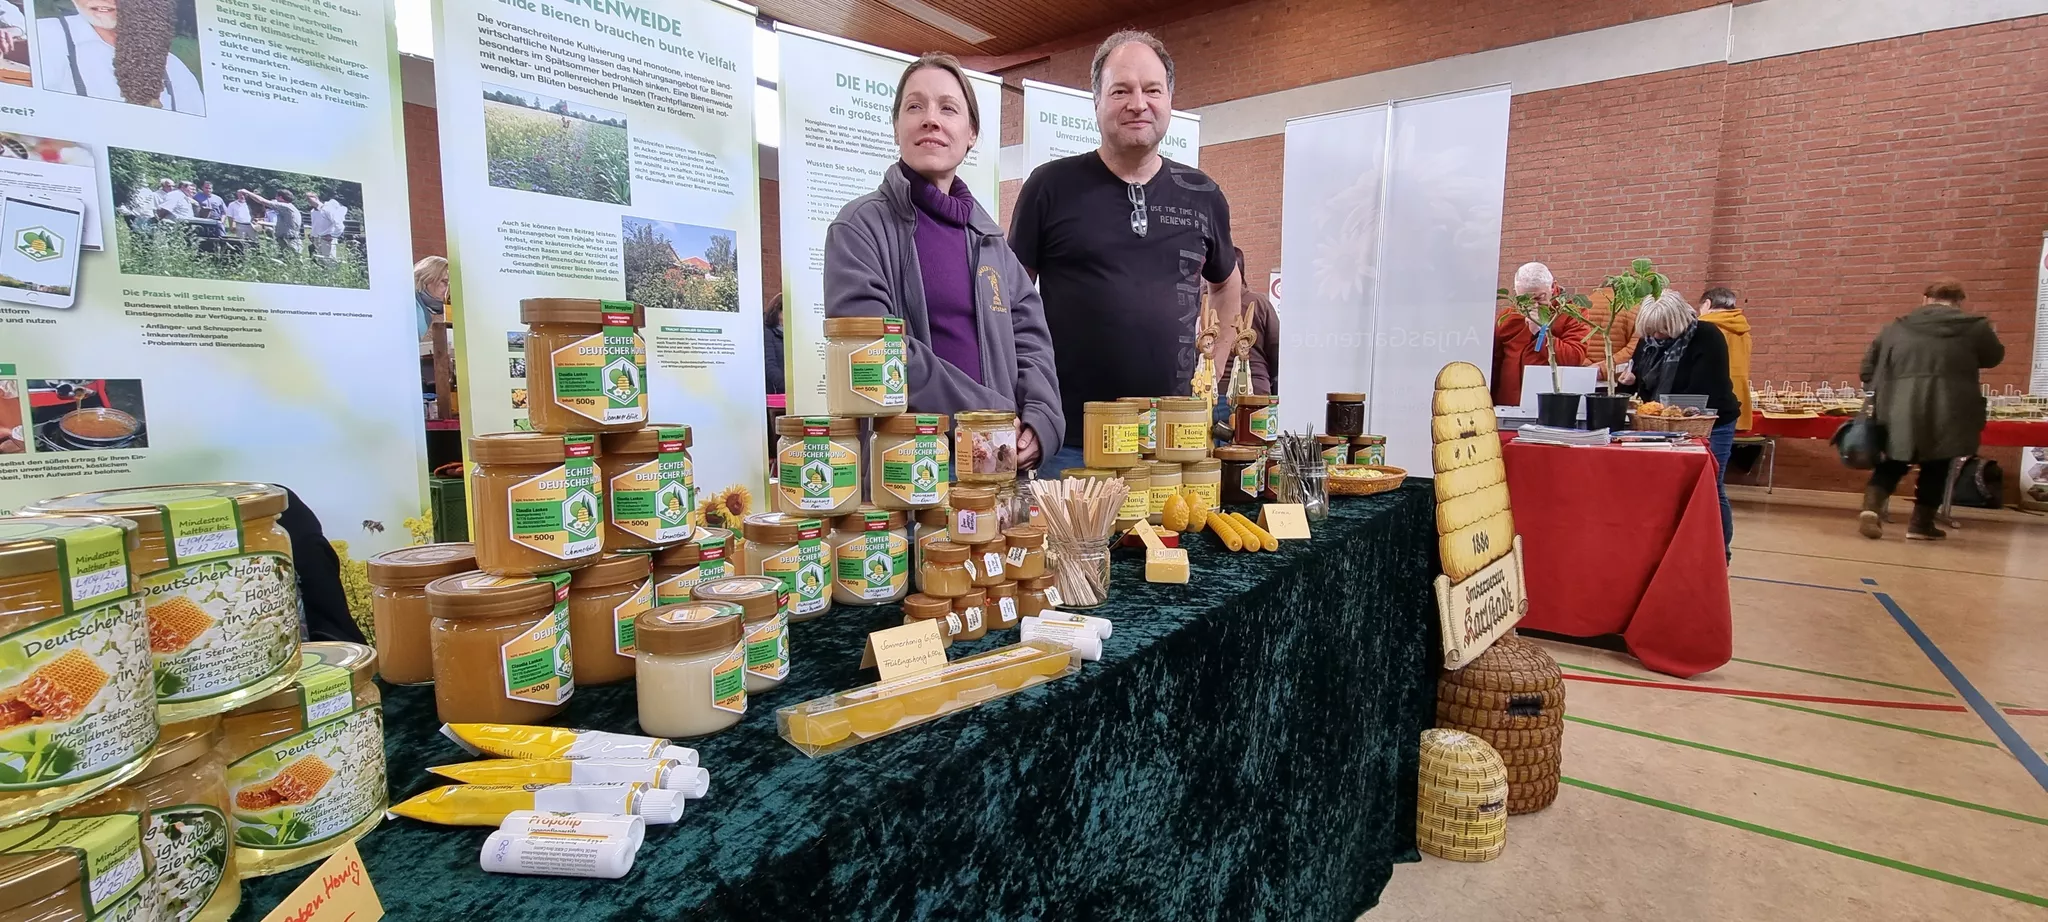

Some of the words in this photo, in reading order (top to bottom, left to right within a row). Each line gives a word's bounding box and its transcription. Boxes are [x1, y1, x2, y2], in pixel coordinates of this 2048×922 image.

[216, 5, 251, 20] Beitrag
[254, 14, 267, 22] für
[270, 19, 290, 28] eine
[293, 23, 324, 38] intakte
[327, 33, 358, 46] Umwelt
[252, 4, 267, 12] Sie
[270, 9, 295, 20] einen
[298, 16, 343, 33] wertvollen
[218, 17, 236, 25] und
[240, 22, 258, 30] den
[261, 26, 318, 45] Klimaschutz.
[541, 3, 590, 29] Bienen
[595, 19, 655, 48] brauchen
[659, 38, 694, 59] bunte
[698, 50, 736, 72] Vielfalt
[219, 30, 265, 45] gewinnen
[268, 40, 282, 48] Sie
[285, 44, 325, 59] wertvolle
[328, 55, 368, 70] Naturpro-
[477, 12, 493, 24] Die
[496, 19, 574, 47] voranschreitende
[577, 41, 625, 62] Kultivierung
[627, 56, 642, 65] und
[644, 61, 683, 78] monotone,
[684, 71, 714, 86] intensive
[716, 80, 732, 90] land-
[220, 40, 249, 51] dukte
[252, 47, 270, 56] und
[273, 52, 288, 60] die
[291, 55, 345, 75] Möglichkeit,
[347, 69, 370, 80] diese
[478, 26, 547, 51] wirtschaftliche
[550, 45, 586, 62] Nutzung
[588, 55, 614, 68] lassen
[617, 64, 631, 72] das
[633, 67, 698, 91] Nahrungsangebot
[699, 85, 709, 93] für
[711, 88, 733, 100] Bienen
[479, 37, 529, 57] besonders
[532, 53, 542, 61] im
[545, 55, 599, 75] Spätsommer
[602, 69, 643, 86] bedrohlich
[645, 81, 671, 94] sinken.
[673, 88, 692, 98] Eine
[691, 92, 732, 110] Bienenweide
[222, 63, 258, 77] können
[262, 71, 277, 80] Sie
[279, 74, 288, 83] in
[290, 77, 318, 89] jedem
[321, 84, 341, 94] Alter
[343, 89, 370, 101] begin-
[836, 72, 861, 91] DIE
[830, 105, 845, 116] ein
[848, 109, 881, 123] großes
[1040, 111, 1058, 125] DIE
[806, 158, 834, 169] Wussten
[846, 164, 867, 175] schon,
[869, 168, 882, 176] dass
[1165, 206, 1176, 214] THE
[1179, 208, 1192, 216] TIME
[1160, 215, 1191, 226] RENEWS
[143, 290, 171, 298] Praxis
[192, 293, 225, 301] gelernt
[124, 302, 172, 310] Bundesweit
[203, 325, 262, 333] Schnupperkurse
[604, 336, 634, 344] ECHTER
[579, 346, 629, 355] DEUTSCHER
[804, 443, 830, 451] ECHTER
[565, 467, 593, 477] ECHTER
[659, 461, 684, 470] ECHTER
[636, 471, 680, 480] DEUTSCHER
[539, 479, 590, 490] DEUTSCHER
[179, 515, 229, 528] Mindestens
[180, 526, 214, 537] haltbar
[798, 545, 820, 554] ECHTER
[850, 544, 884, 552] DEUTSCHER
[1471, 530, 1489, 556] 1886
[75, 549, 120, 565] Mindestens
[781, 552, 817, 563] DEUTSCHER
[76, 562, 107, 575] haltbar
[234, 562, 271, 577] Honig
[700, 565, 725, 577] ECHTER
[1466, 568, 1505, 604] Imkerverein
[227, 615, 243, 625] in
[1464, 582, 1514, 649] Karlstadt
[24, 615, 123, 658] Deutscher
[160, 652, 201, 668] Imkerei
[205, 645, 238, 659] Stefan
[242, 633, 275, 647] Kummer
[182, 669, 222, 683] 97282
[225, 655, 267, 673] Retzstadt
[759, 662, 775, 671] 250g
[120, 670, 134, 682] in
[180, 684, 201, 695] Tel.:
[311, 681, 347, 696] Mindestens
[531, 682, 550, 693] 500g
[726, 695, 739, 705] 250g
[51, 719, 97, 742] Imkerei
[101, 706, 131, 725] Stefan
[77, 737, 117, 758] 97282
[275, 723, 347, 761] Deutscher
[293, 803, 325, 818] Imkerei
[328, 791, 352, 805] Stefan
[157, 821, 211, 859] igwabe
[159, 827, 225, 876] zienhonig
[323, 857, 360, 899] Honig
